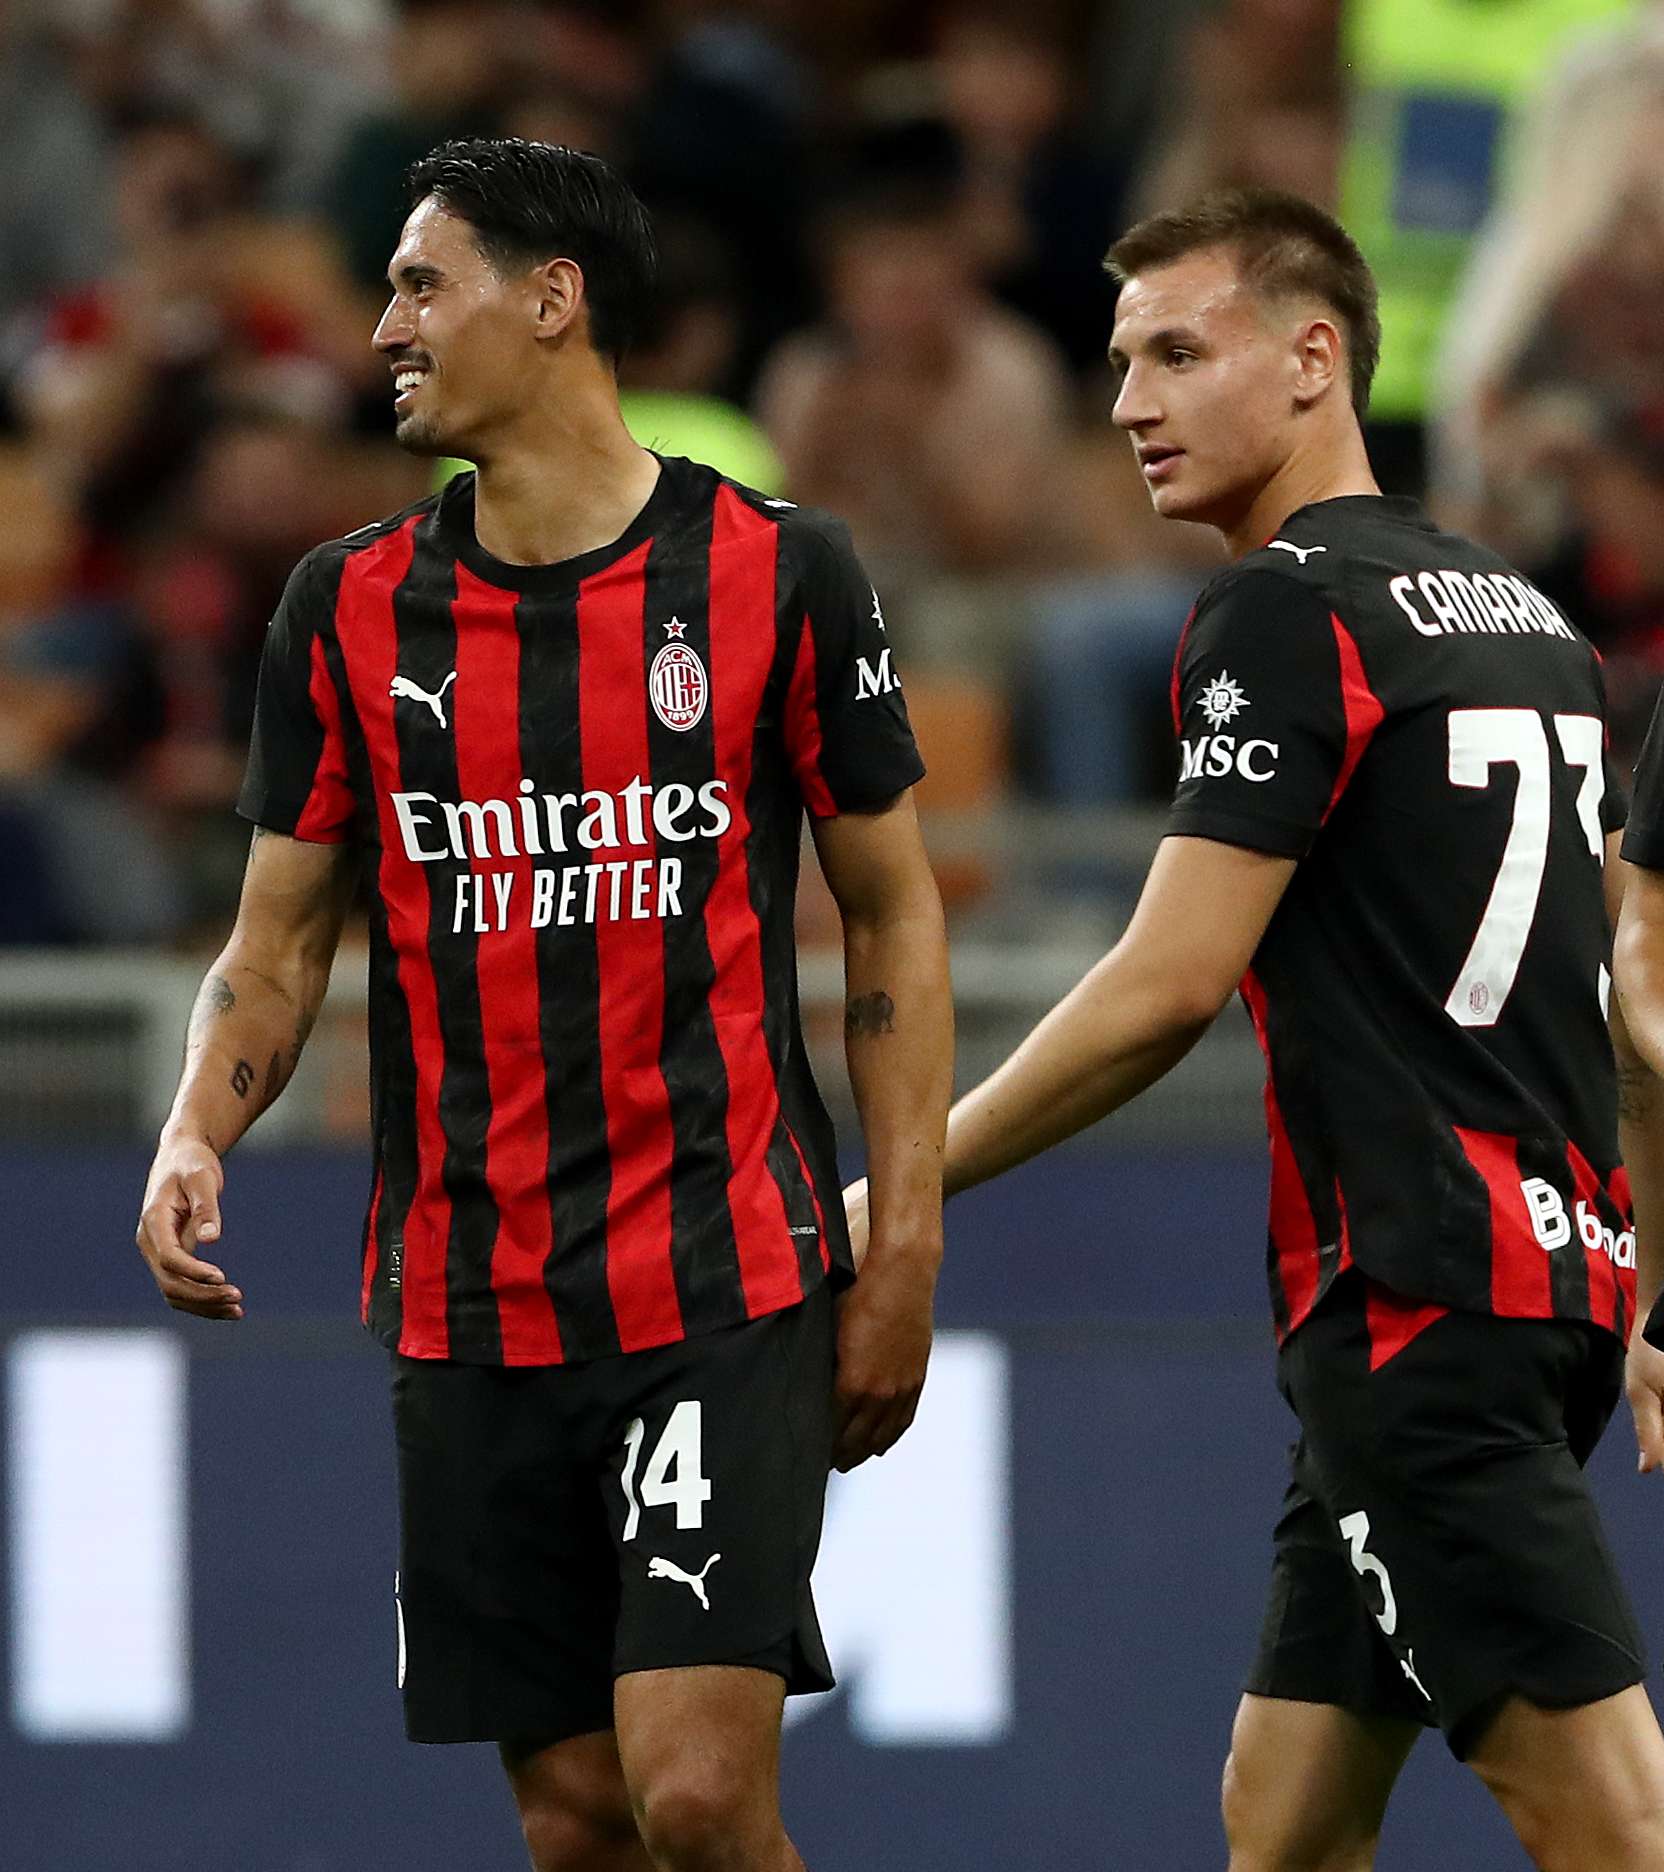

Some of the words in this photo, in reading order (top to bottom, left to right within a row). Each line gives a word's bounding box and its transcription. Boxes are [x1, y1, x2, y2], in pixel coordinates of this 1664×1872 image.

[661, 650, 693, 668] ACM
[1178, 734, 1279, 782] MSC
[390, 775, 731, 862] Emirates
[452, 873, 514, 934] FLY
[530, 857, 683, 928] BETTER
[620, 1400, 712, 1542] 14
